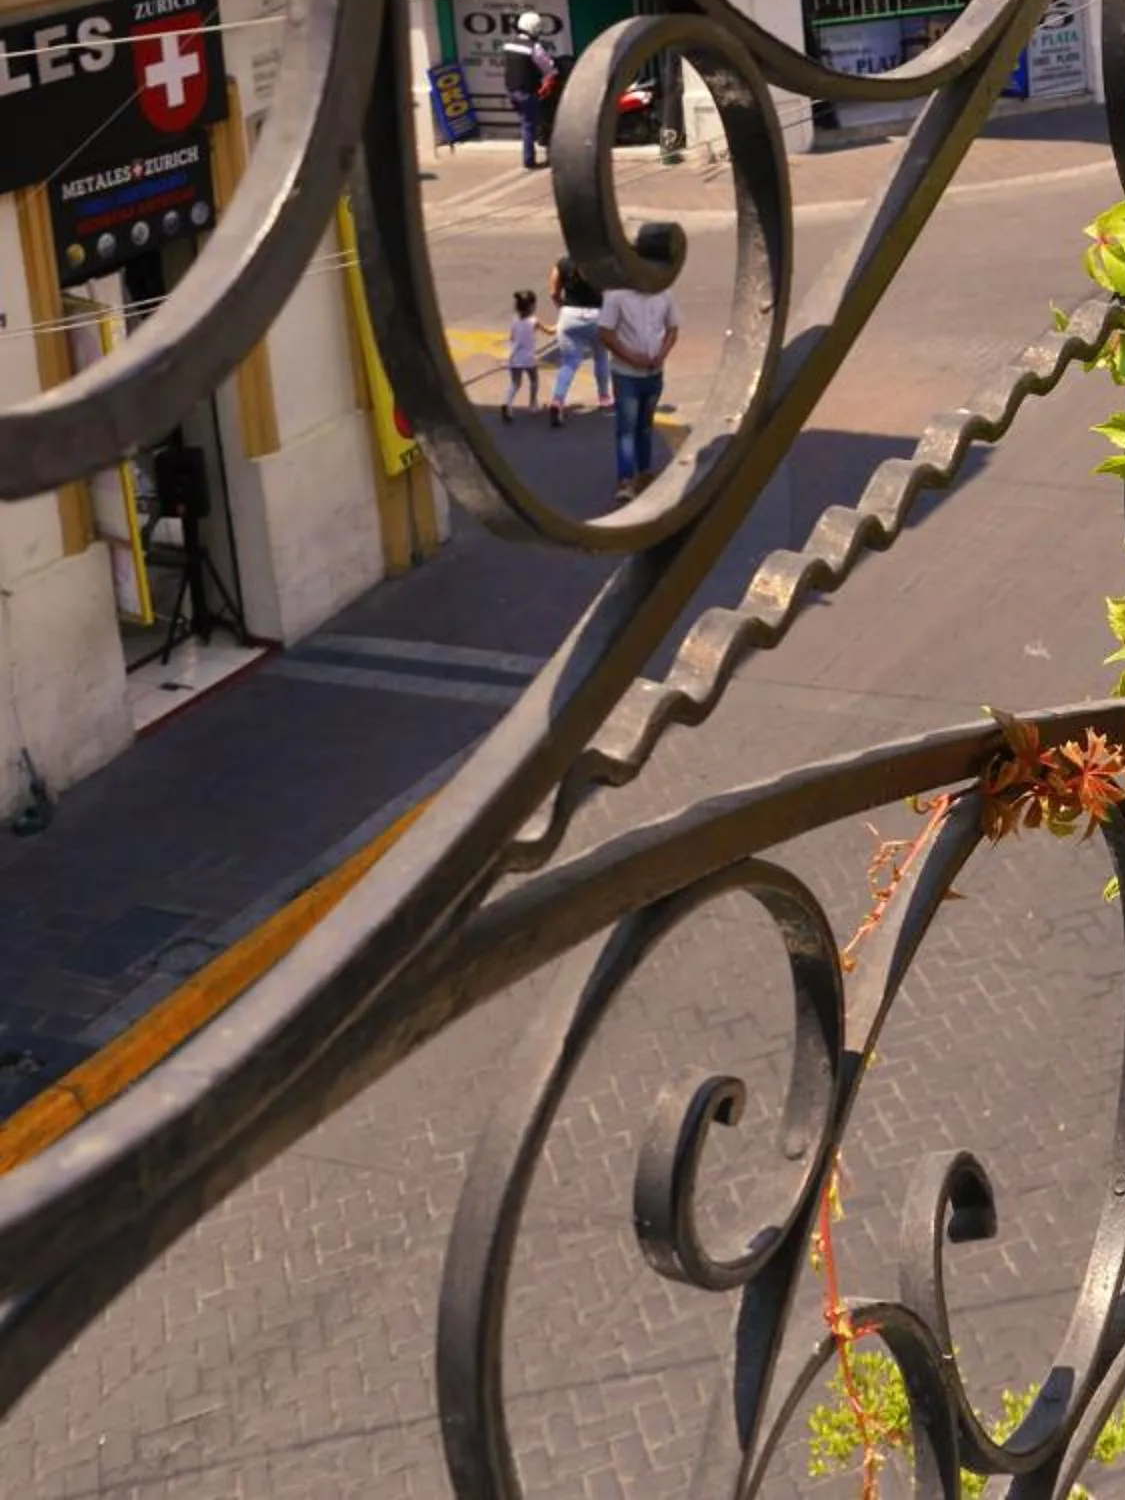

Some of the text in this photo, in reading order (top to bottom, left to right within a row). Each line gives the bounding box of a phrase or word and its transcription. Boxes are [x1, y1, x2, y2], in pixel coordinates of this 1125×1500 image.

[462, 11, 564, 36] ORO
[61, 166, 132, 201] METALES
[143, 145, 200, 177] ZURICH
